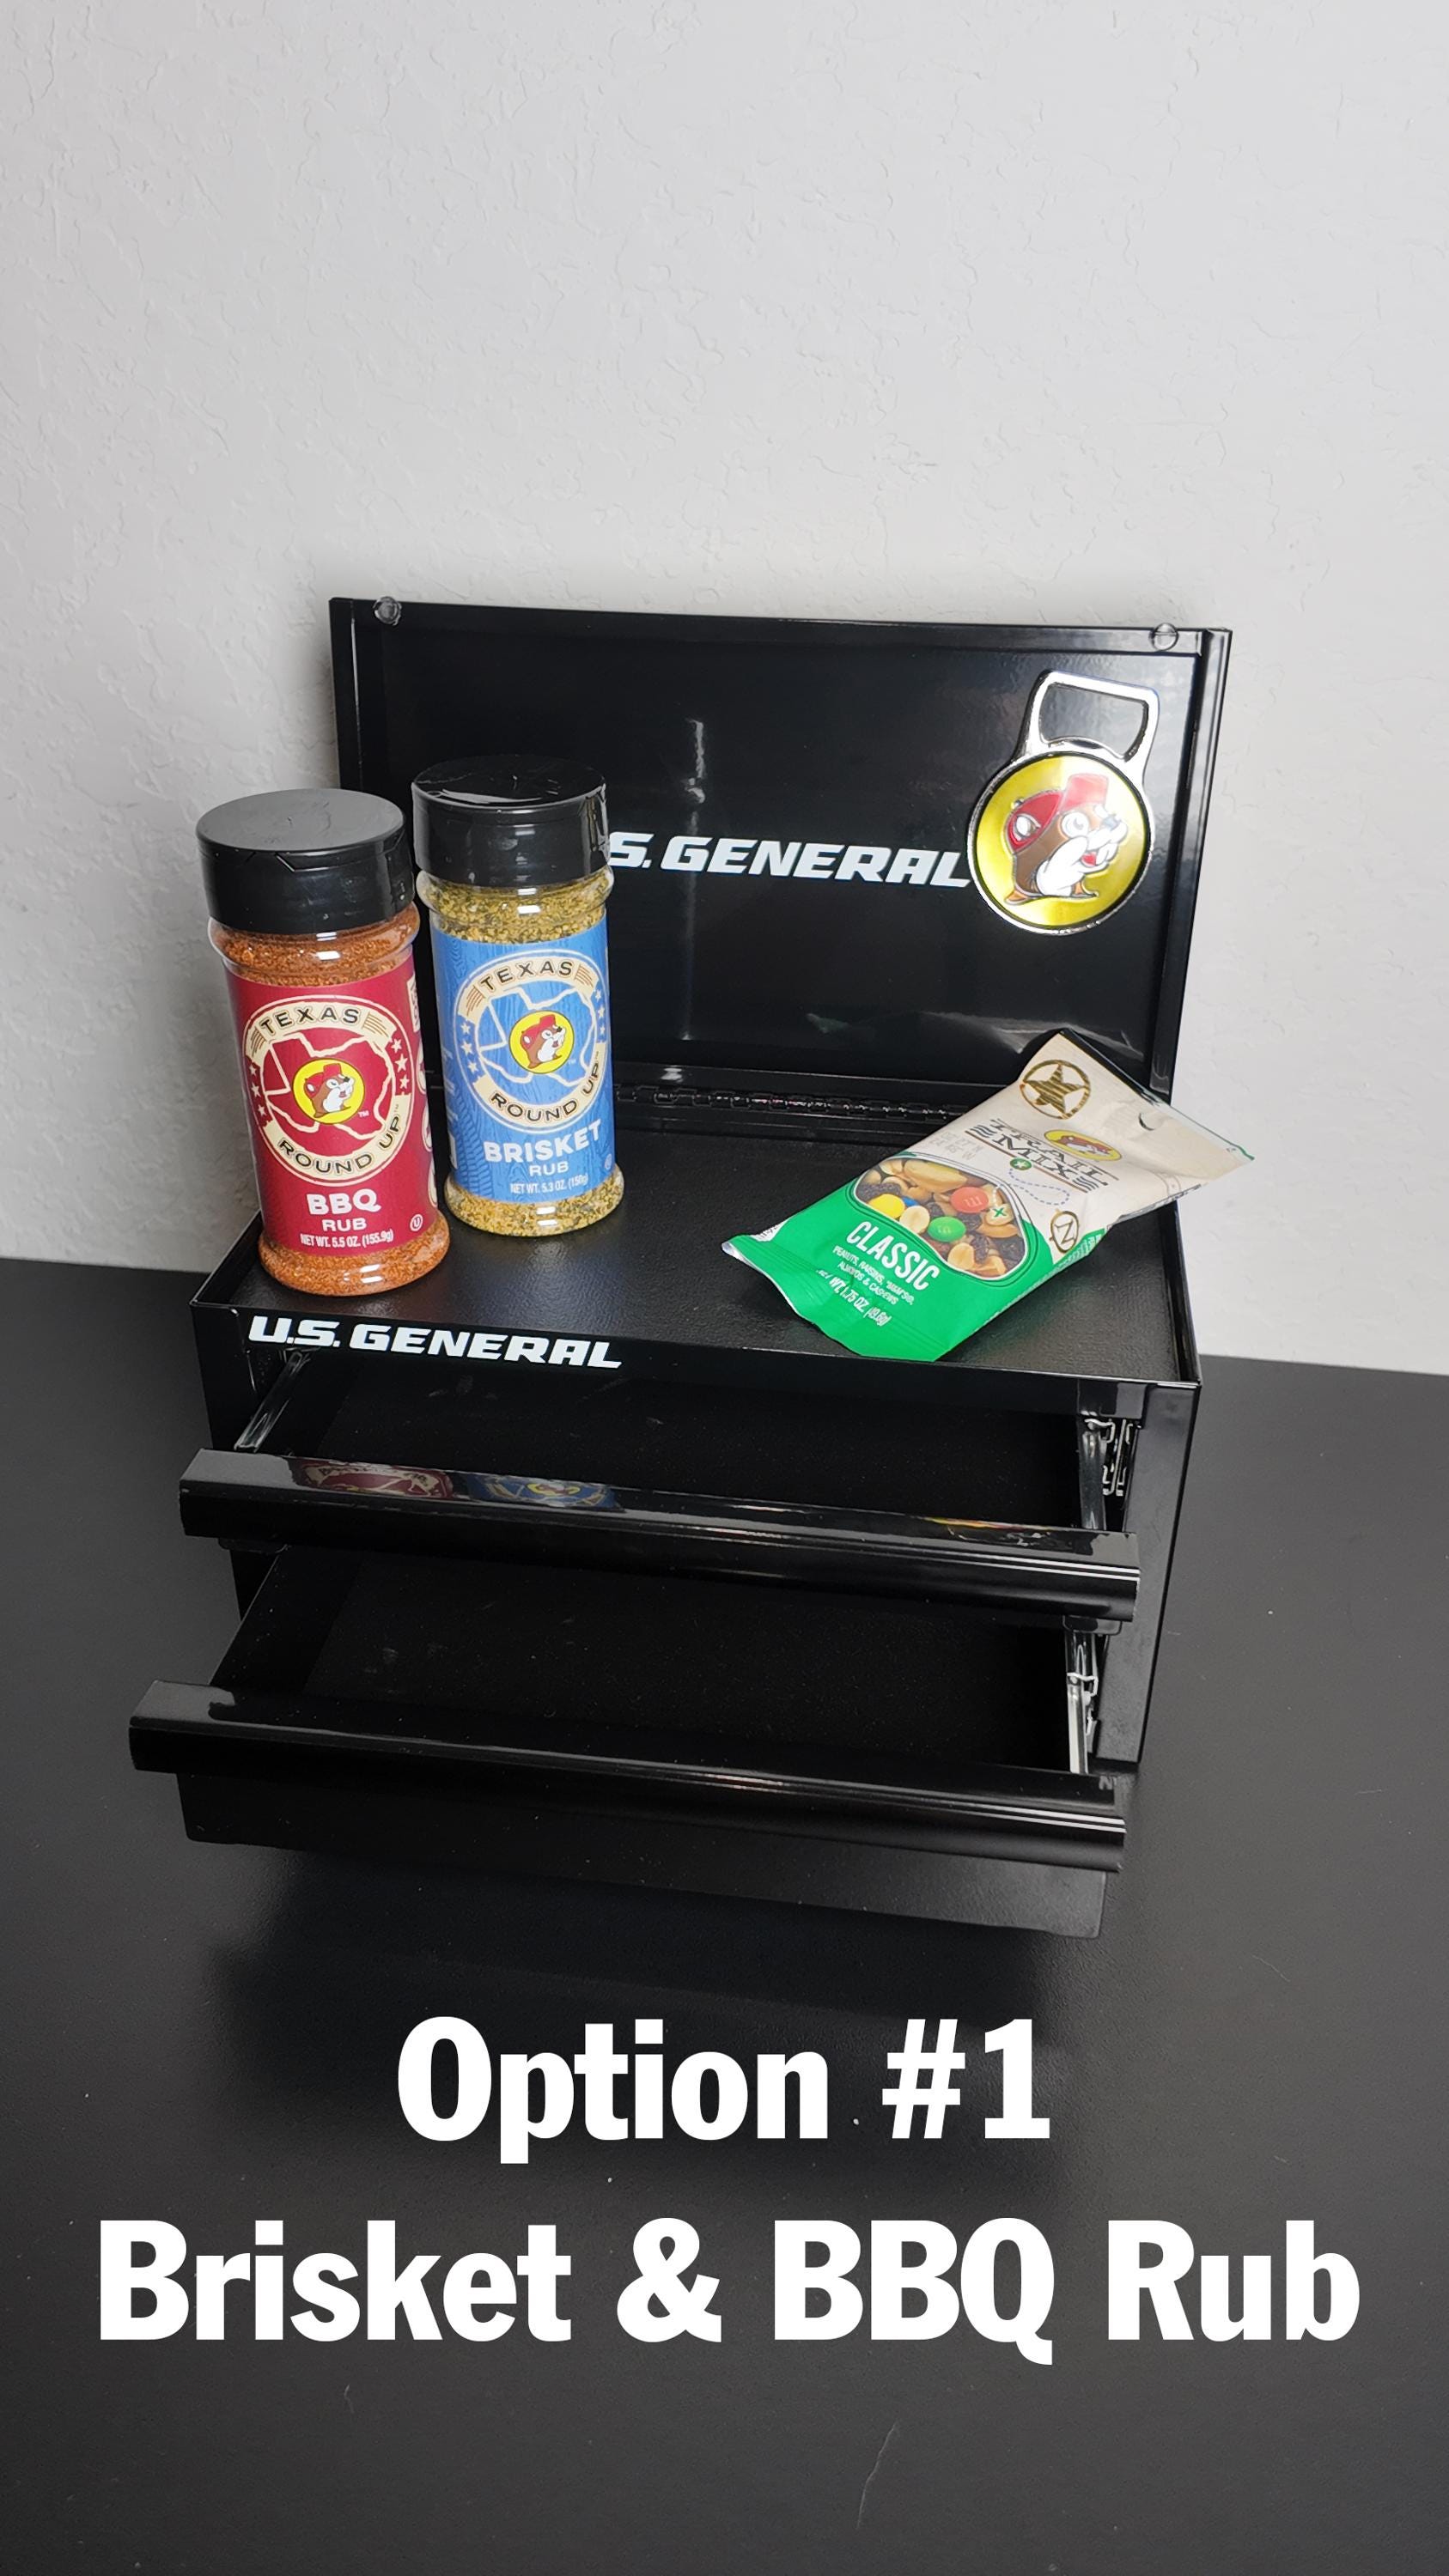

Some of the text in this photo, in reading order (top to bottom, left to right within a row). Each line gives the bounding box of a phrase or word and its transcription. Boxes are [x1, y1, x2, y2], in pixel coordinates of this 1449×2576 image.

[607, 831, 971, 888] S. GENERAL
[481, 960, 574, 991] TEXAS
[260, 1006, 361, 1036] TEXAS
[491, 1062, 599, 1121] ROUND UP
[278, 1116, 399, 1174] ROUND UP
[483, 1119, 601, 1163] BRISKET
[989, 1118, 1109, 1187] TRAIL
[993, 1133, 1074, 1180] MIX
[510, 1182, 525, 1194] NET
[526, 1182, 539, 1194] WT.
[555, 1179, 567, 1191] OZ.
[529, 1161, 569, 1176] RUB
[306, 1188, 381, 1215] BBQ
[301, 1229, 394, 1248] NET WT. 5.5 OZ. (155.9g)
[322, 1218, 367, 1231] RUB
[846, 1221, 941, 1291] CLASSIC
[862, 1277, 870, 1285] &
[249, 1315, 621, 1369] U.S. GENERAL
